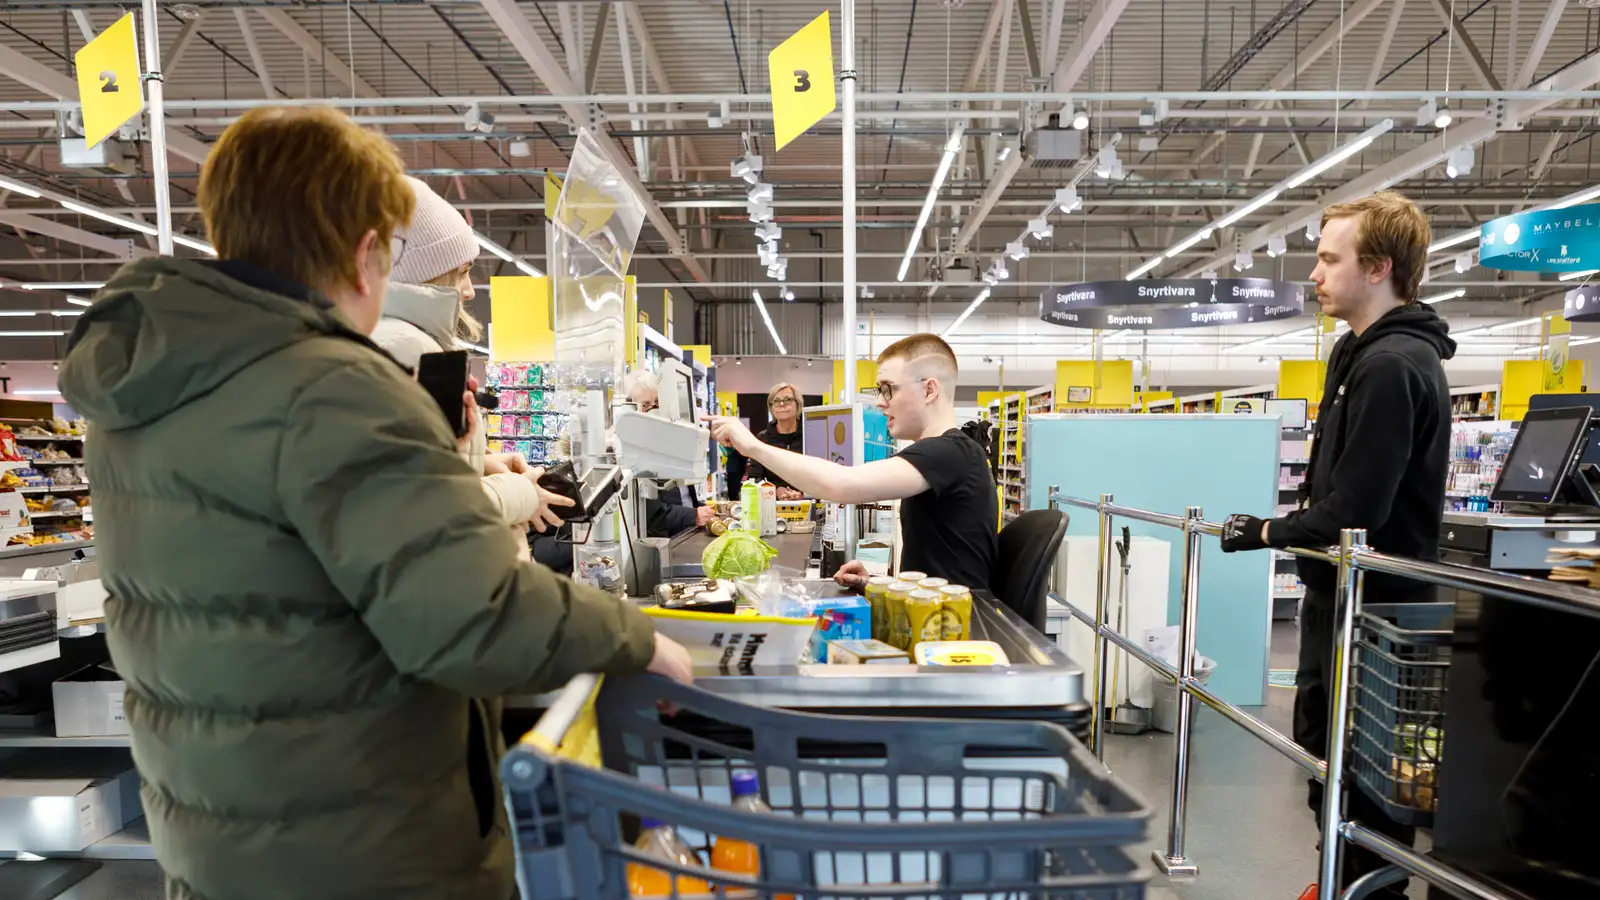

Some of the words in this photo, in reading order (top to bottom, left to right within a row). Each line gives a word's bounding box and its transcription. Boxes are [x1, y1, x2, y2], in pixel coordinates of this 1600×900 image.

[98, 70, 119, 93] 2
[793, 69, 811, 92] 3
[1533, 217, 1600, 233] MAYBEL
[1056, 290, 1096, 304] Snyrtivara
[1137, 285, 1196, 298] Snyrtivara
[1232, 285, 1275, 299] Snyrtivara
[1107, 314, 1153, 325] Snyrtivara
[1190, 310, 1238, 323] Snyrtivara
